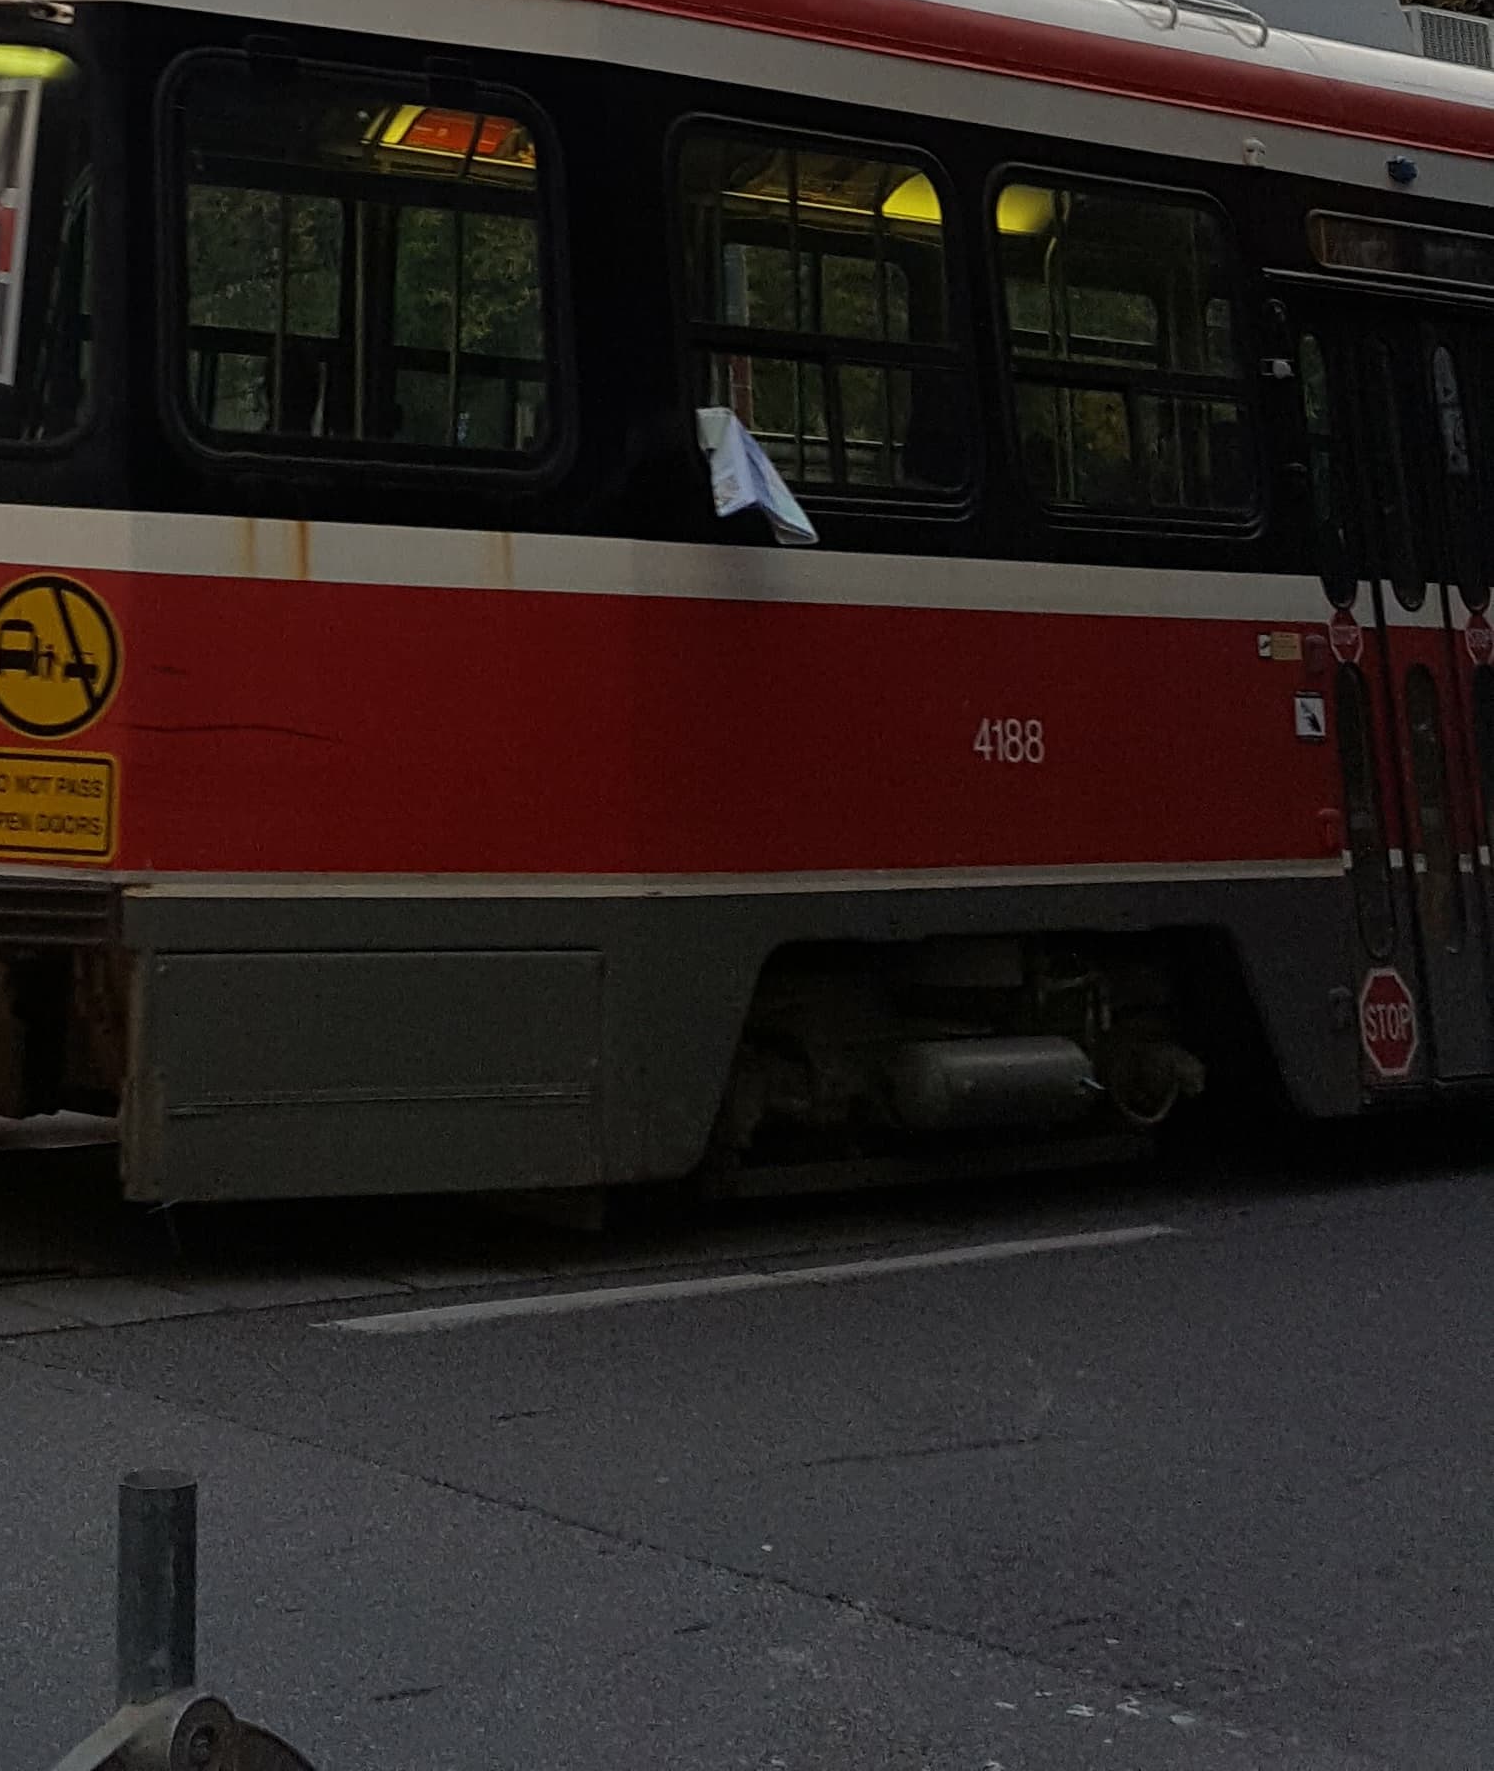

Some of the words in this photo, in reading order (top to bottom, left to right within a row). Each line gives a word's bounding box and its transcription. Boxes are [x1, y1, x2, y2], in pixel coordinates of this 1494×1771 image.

[972, 718, 1046, 764] 4188
[37, 813, 102, 836] DOORS
[1366, 1002, 1411, 1042] STOP
